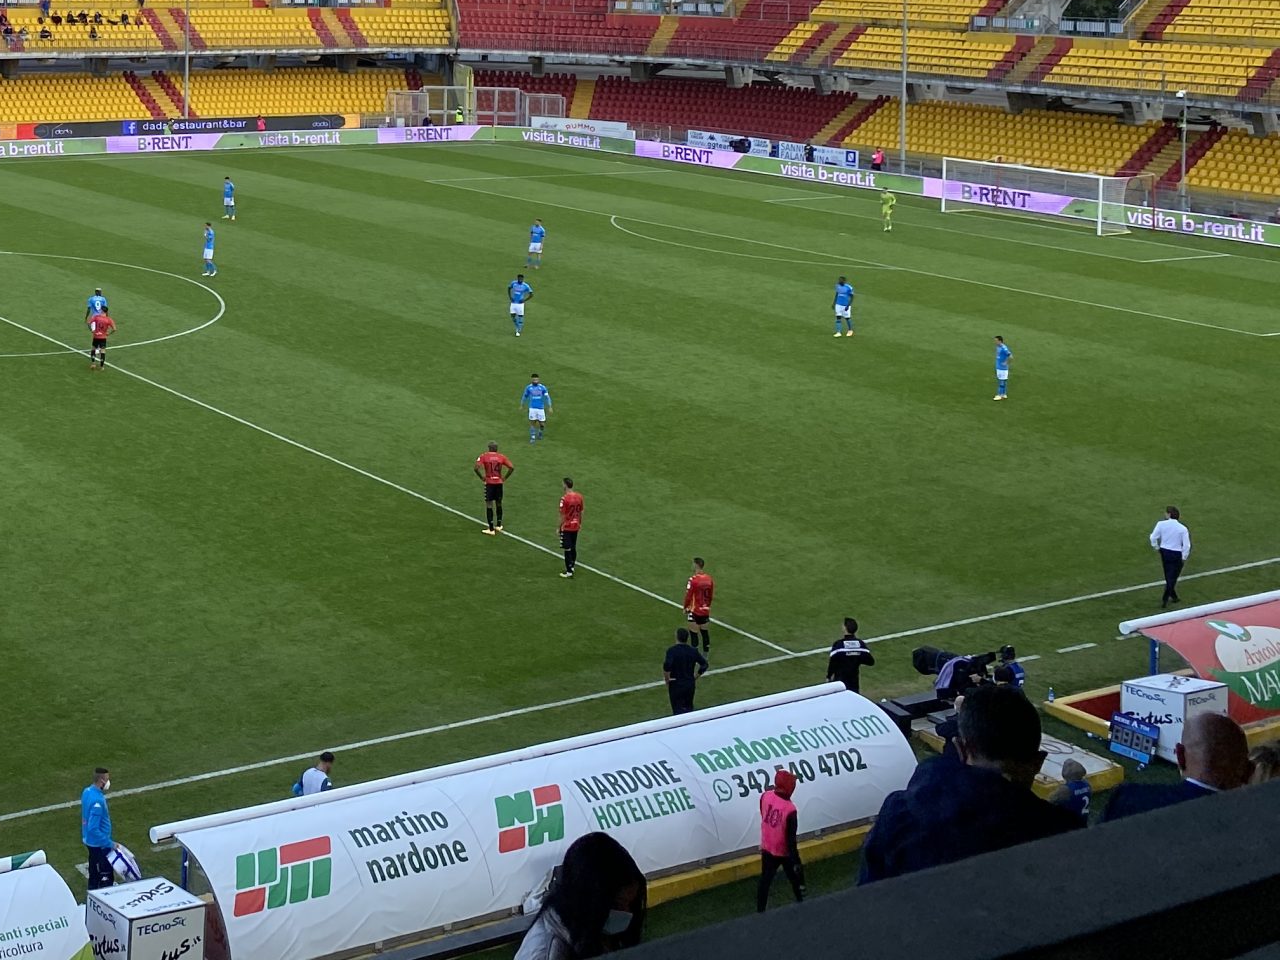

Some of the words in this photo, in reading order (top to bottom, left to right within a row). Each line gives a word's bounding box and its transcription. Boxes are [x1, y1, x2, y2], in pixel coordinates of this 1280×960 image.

[142, 119, 247, 131] dadaestaurant&bar
[258, 133, 289, 147] visita
[292, 131, 340, 145] b-rent.it
[522, 129, 555, 144] visita
[557, 131, 601, 149] b-rent.it
[9, 140, 65, 154] b-rent.it
[780, 162, 815, 178] visita
[818, 164, 876, 187] b-rent.it
[1127, 209, 1176, 229] visita
[1182, 218, 1265, 243] b-rent.it
[690, 714, 890, 775] nardoneforni.com
[573, 759, 682, 804] NARDONE
[731, 768, 775, 798] 342
[773, 759, 816, 785] 40
[818, 747, 868, 778] 4702
[592, 787, 696, 831] HOTELLERIE
[348, 810, 449, 848] martino
[366, 839, 469, 884] nardone
[24, 915, 69, 938] speciali
